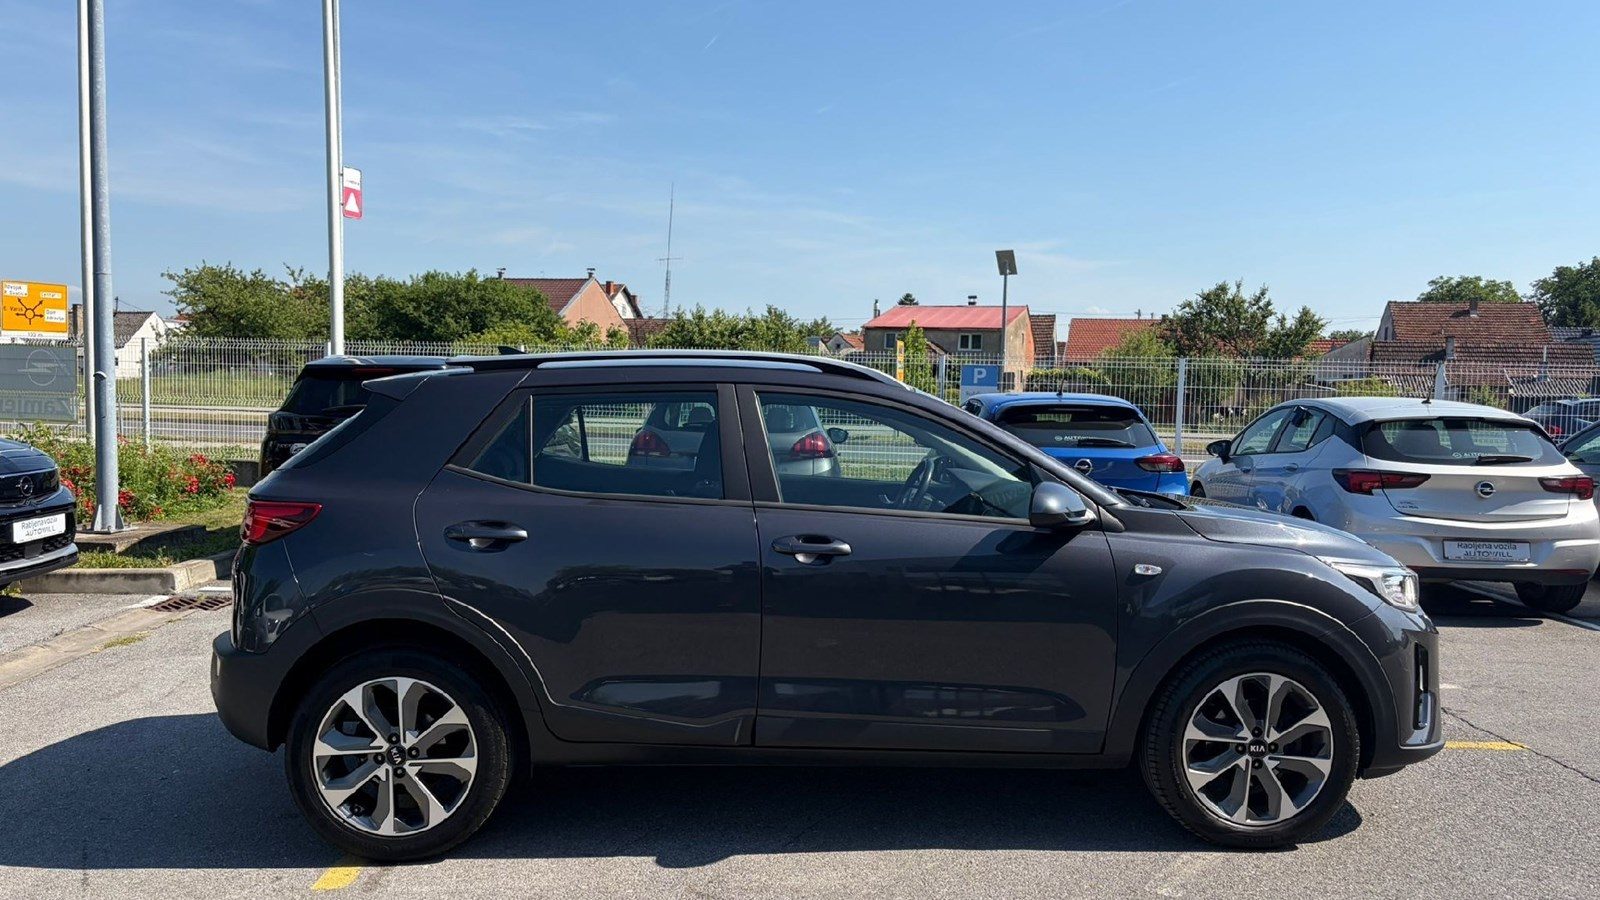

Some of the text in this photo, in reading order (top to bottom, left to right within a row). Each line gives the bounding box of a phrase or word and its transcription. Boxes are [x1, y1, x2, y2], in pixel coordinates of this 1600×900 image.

[973, 367, 987, 384] P
[1494, 542, 1517, 550] vozila
[390, 747, 401, 764] KIA
